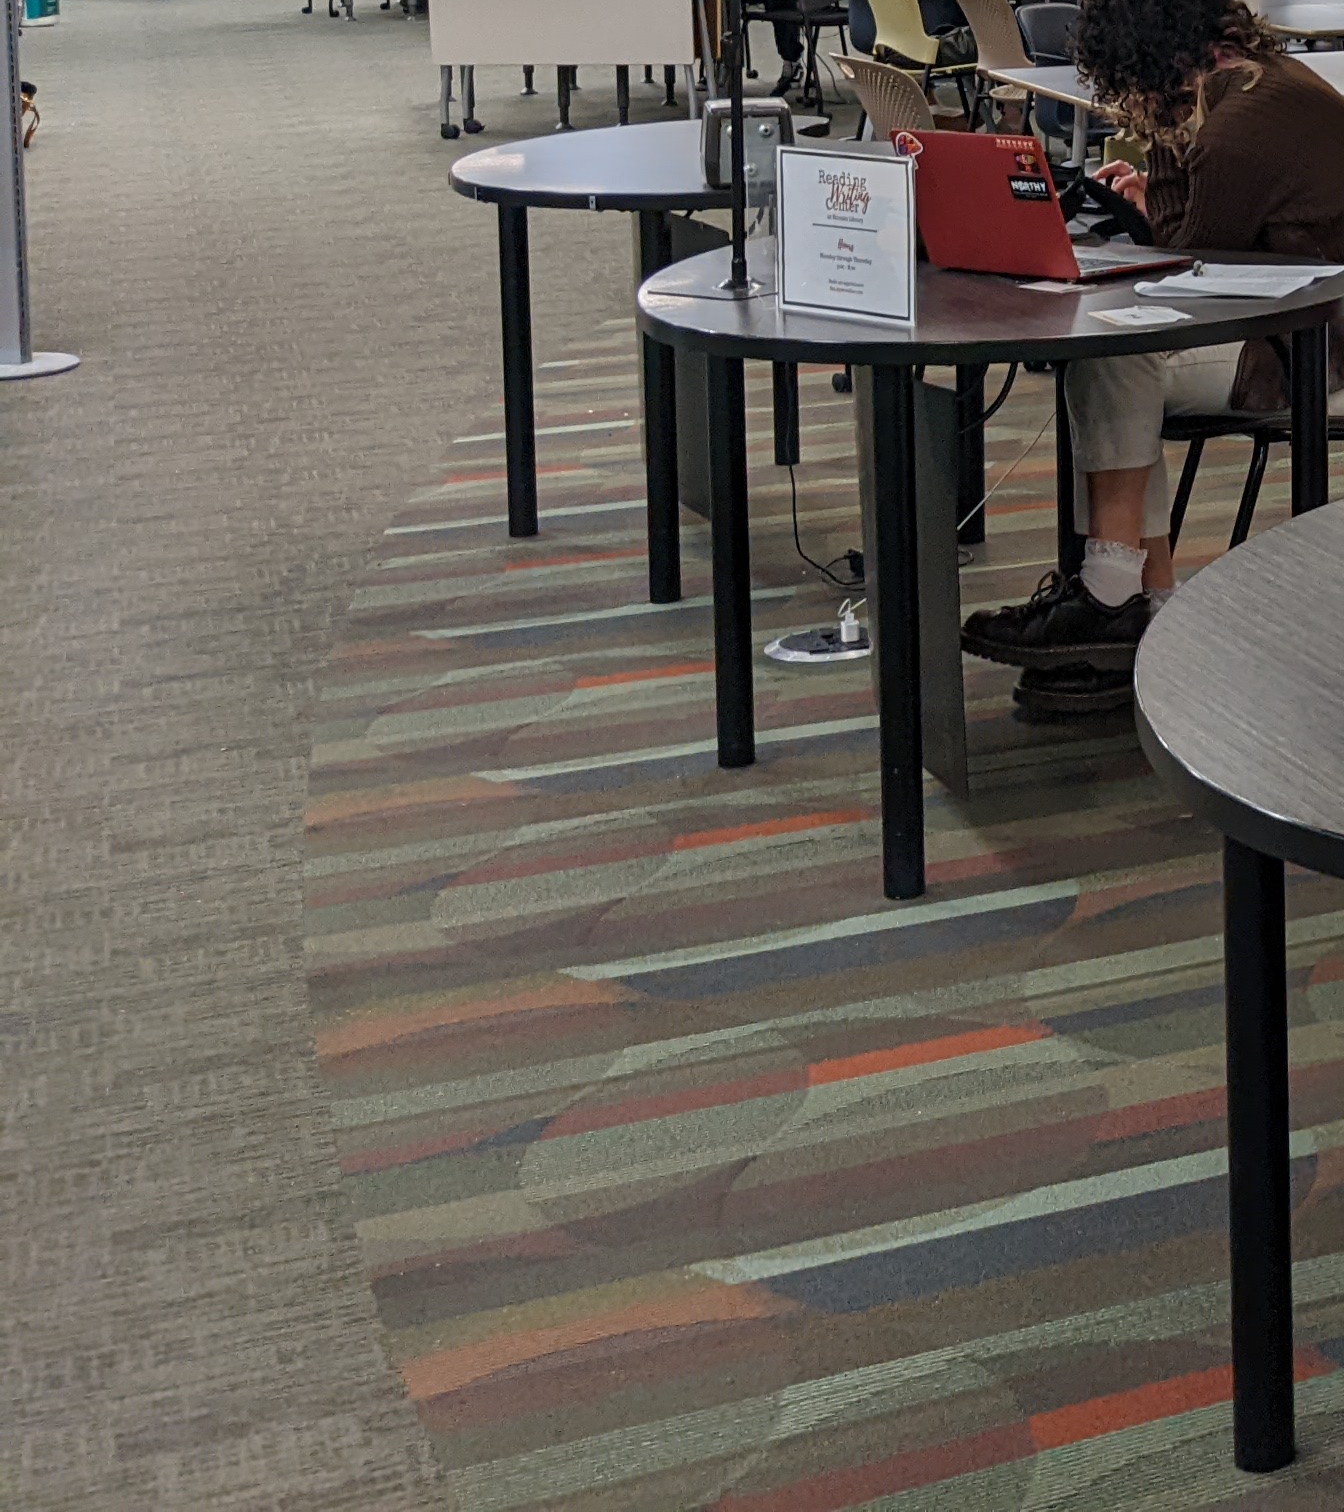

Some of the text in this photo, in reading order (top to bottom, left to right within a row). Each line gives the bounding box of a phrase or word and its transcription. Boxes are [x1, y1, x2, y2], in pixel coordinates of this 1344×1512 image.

[818, 170, 866, 191] Reading
[825, 197, 859, 213] Center
[830, 180, 871, 215] Writing
